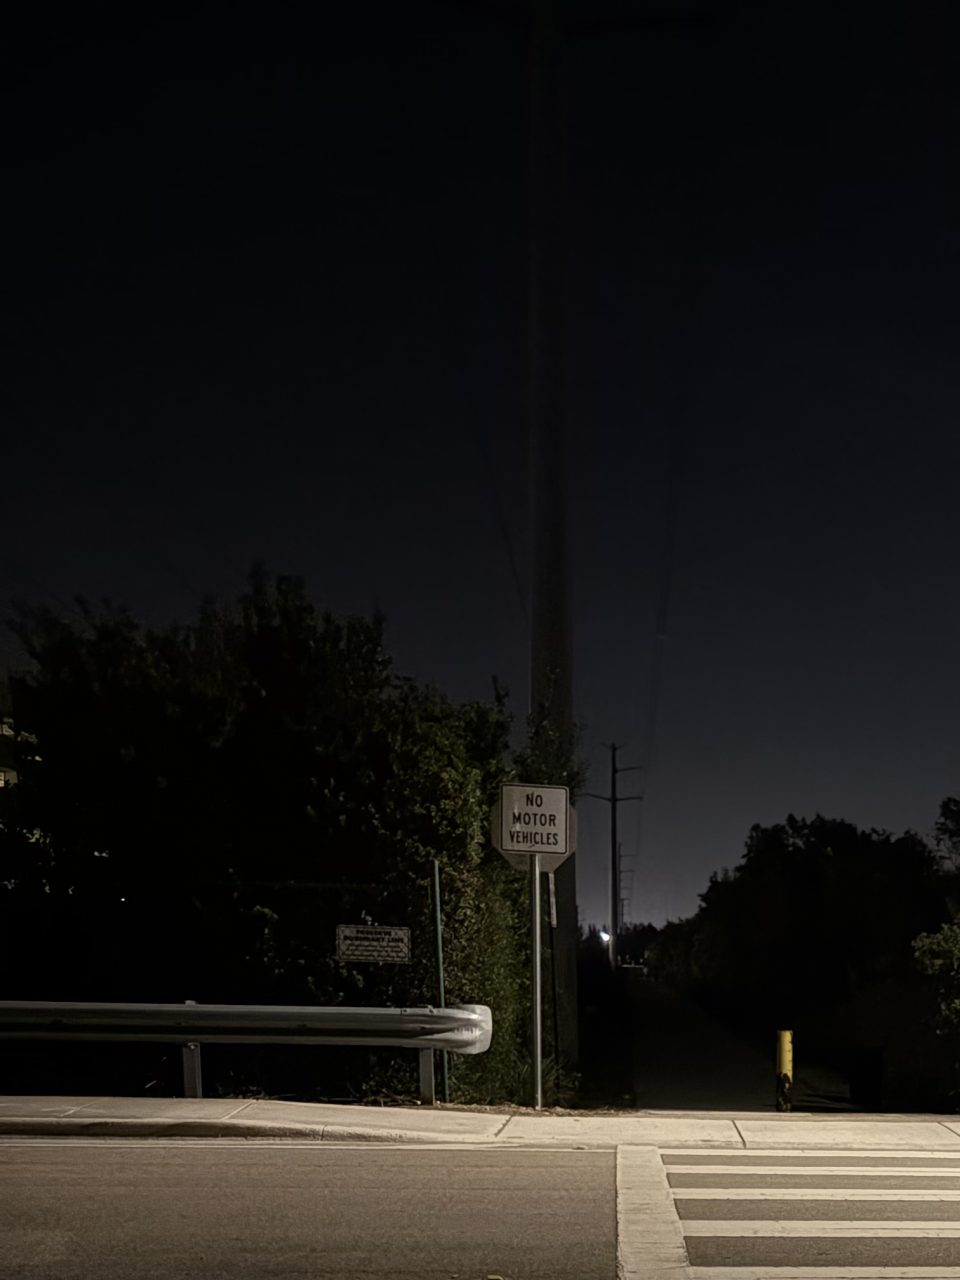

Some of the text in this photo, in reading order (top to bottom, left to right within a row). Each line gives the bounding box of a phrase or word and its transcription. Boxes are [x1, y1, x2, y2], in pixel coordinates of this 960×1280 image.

[526, 793, 543, 807] NO
[512, 812, 556, 827] MOTOR
[509, 831, 558, 846] VEHICLES
